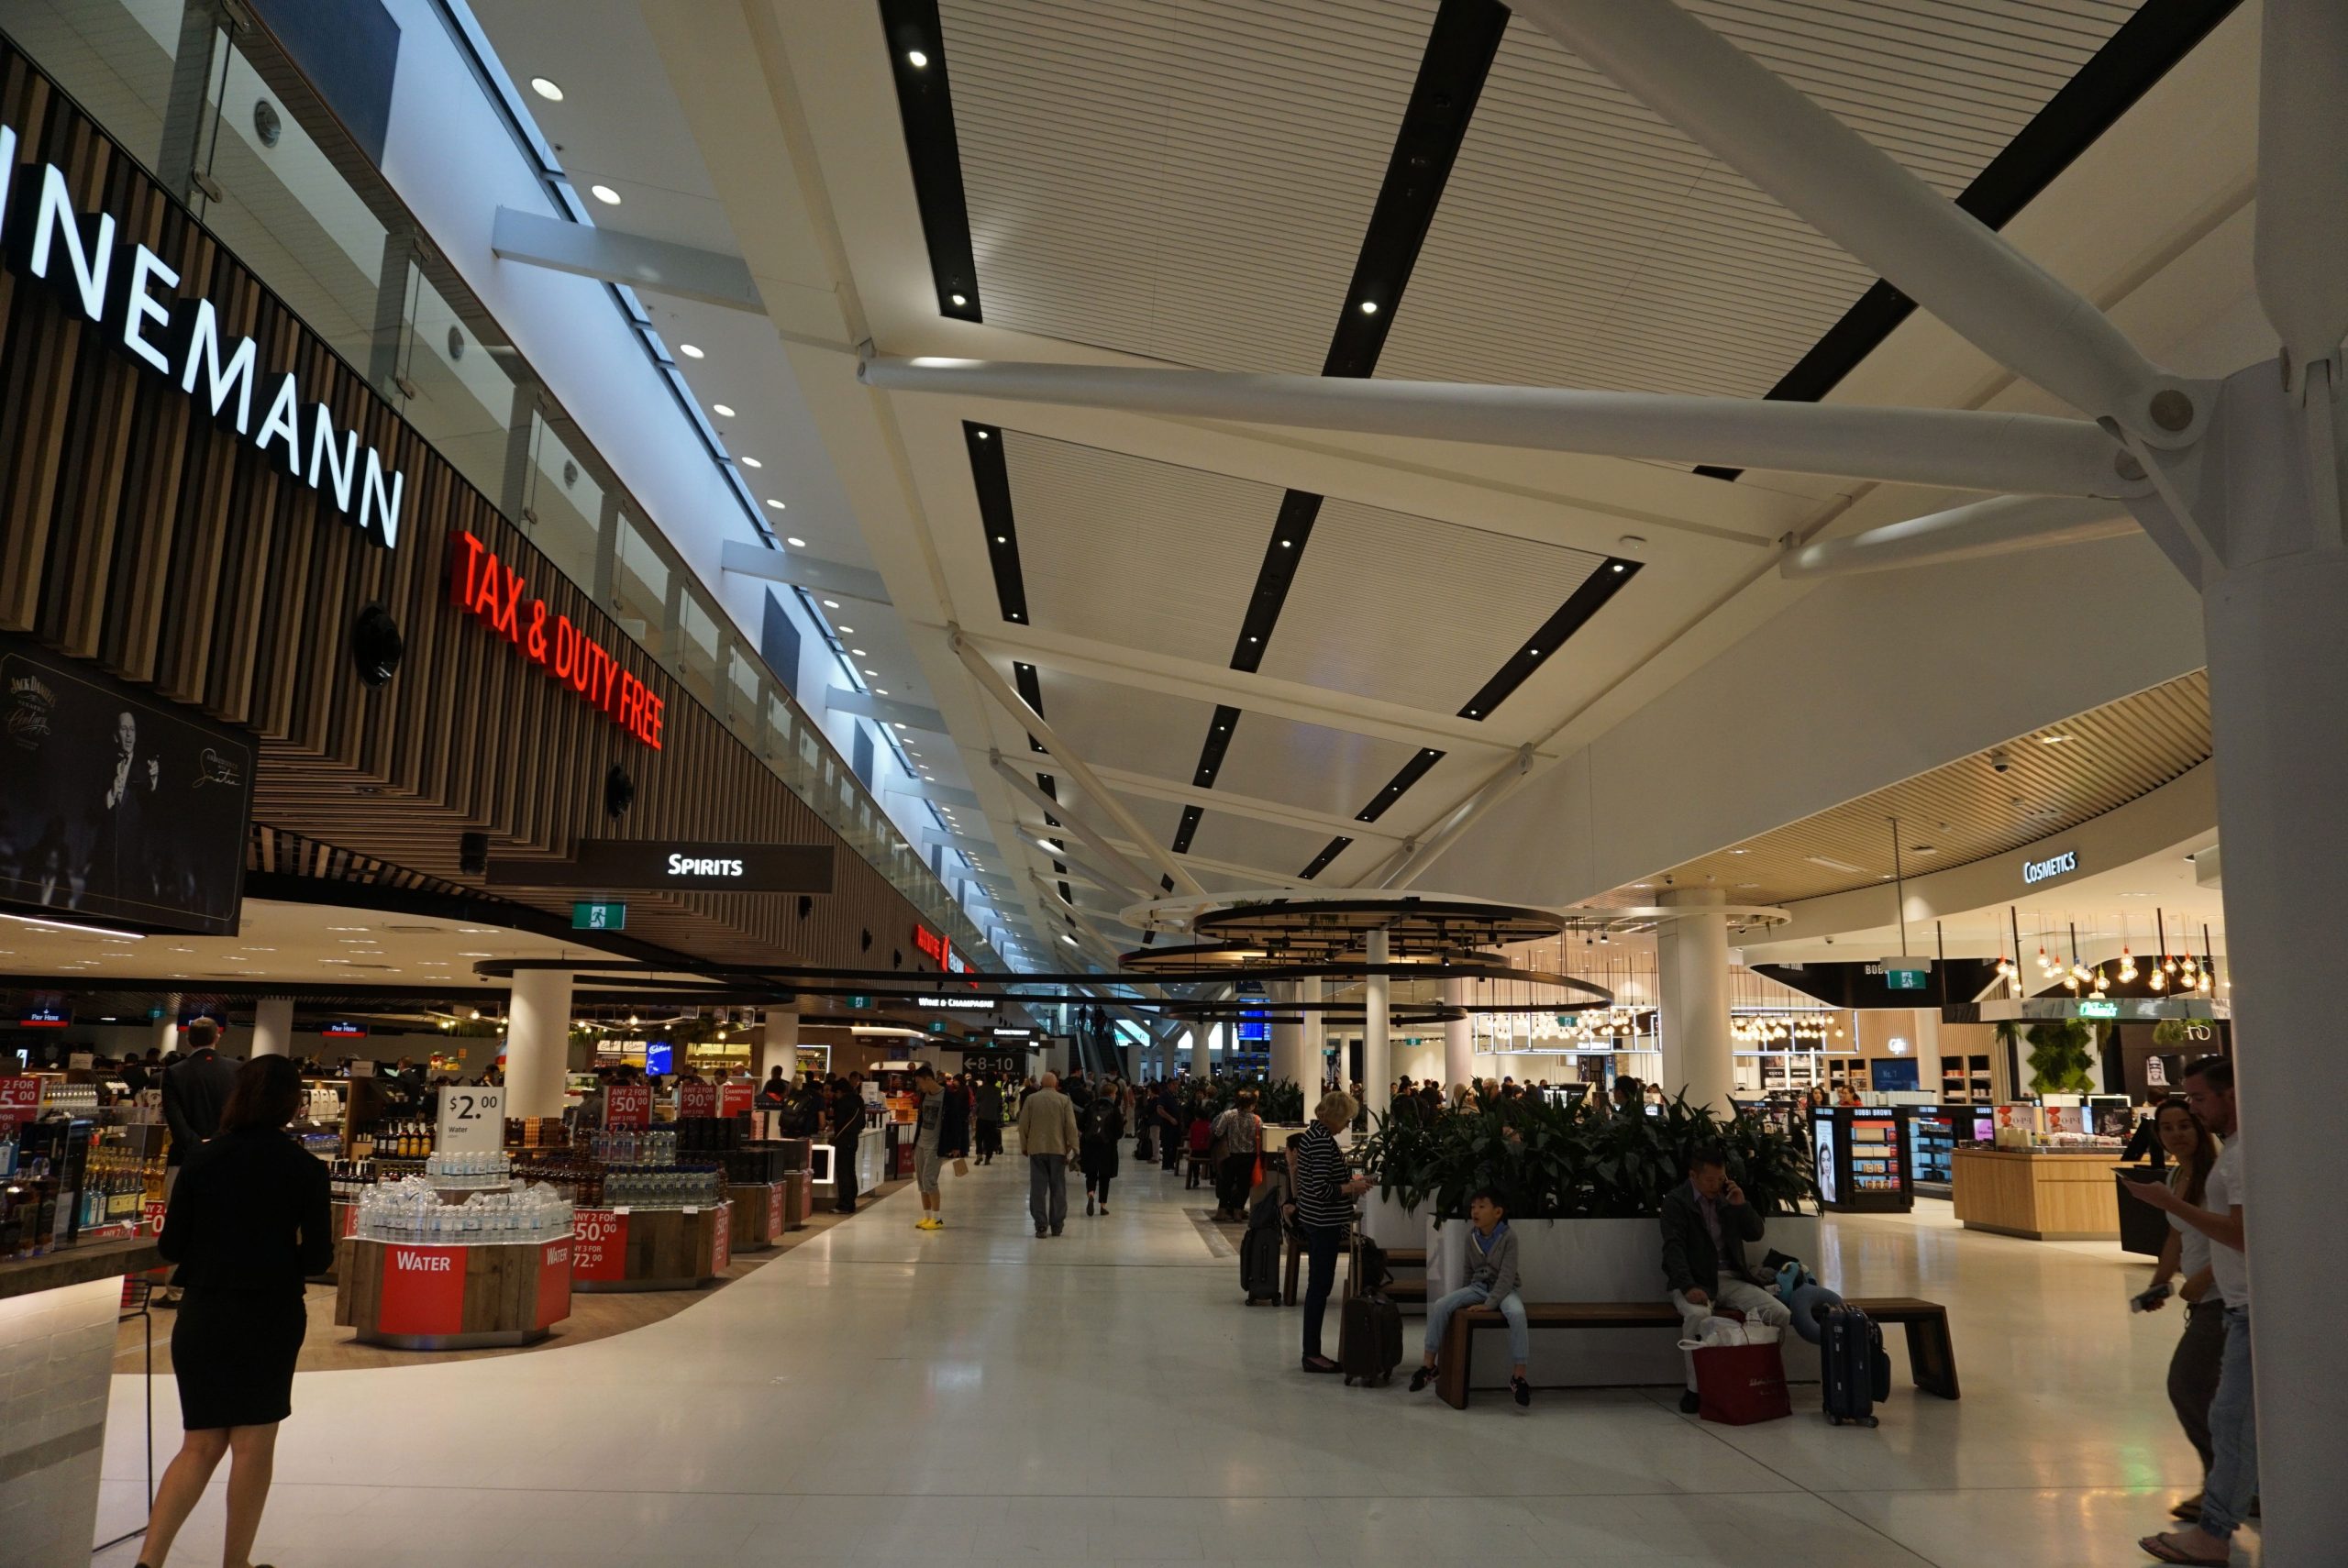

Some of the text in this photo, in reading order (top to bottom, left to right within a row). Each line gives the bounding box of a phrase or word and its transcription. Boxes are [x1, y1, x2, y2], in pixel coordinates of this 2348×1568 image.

[464, 530, 664, 751] TAX & DUTY FREE
[13, 1080, 35, 1089] FOR
[635, 1088, 648, 1097] FOR
[591, 1212, 597, 1222] 2
[599, 1213, 616, 1222] FOR
[588, 1245, 602, 1253] FOR
